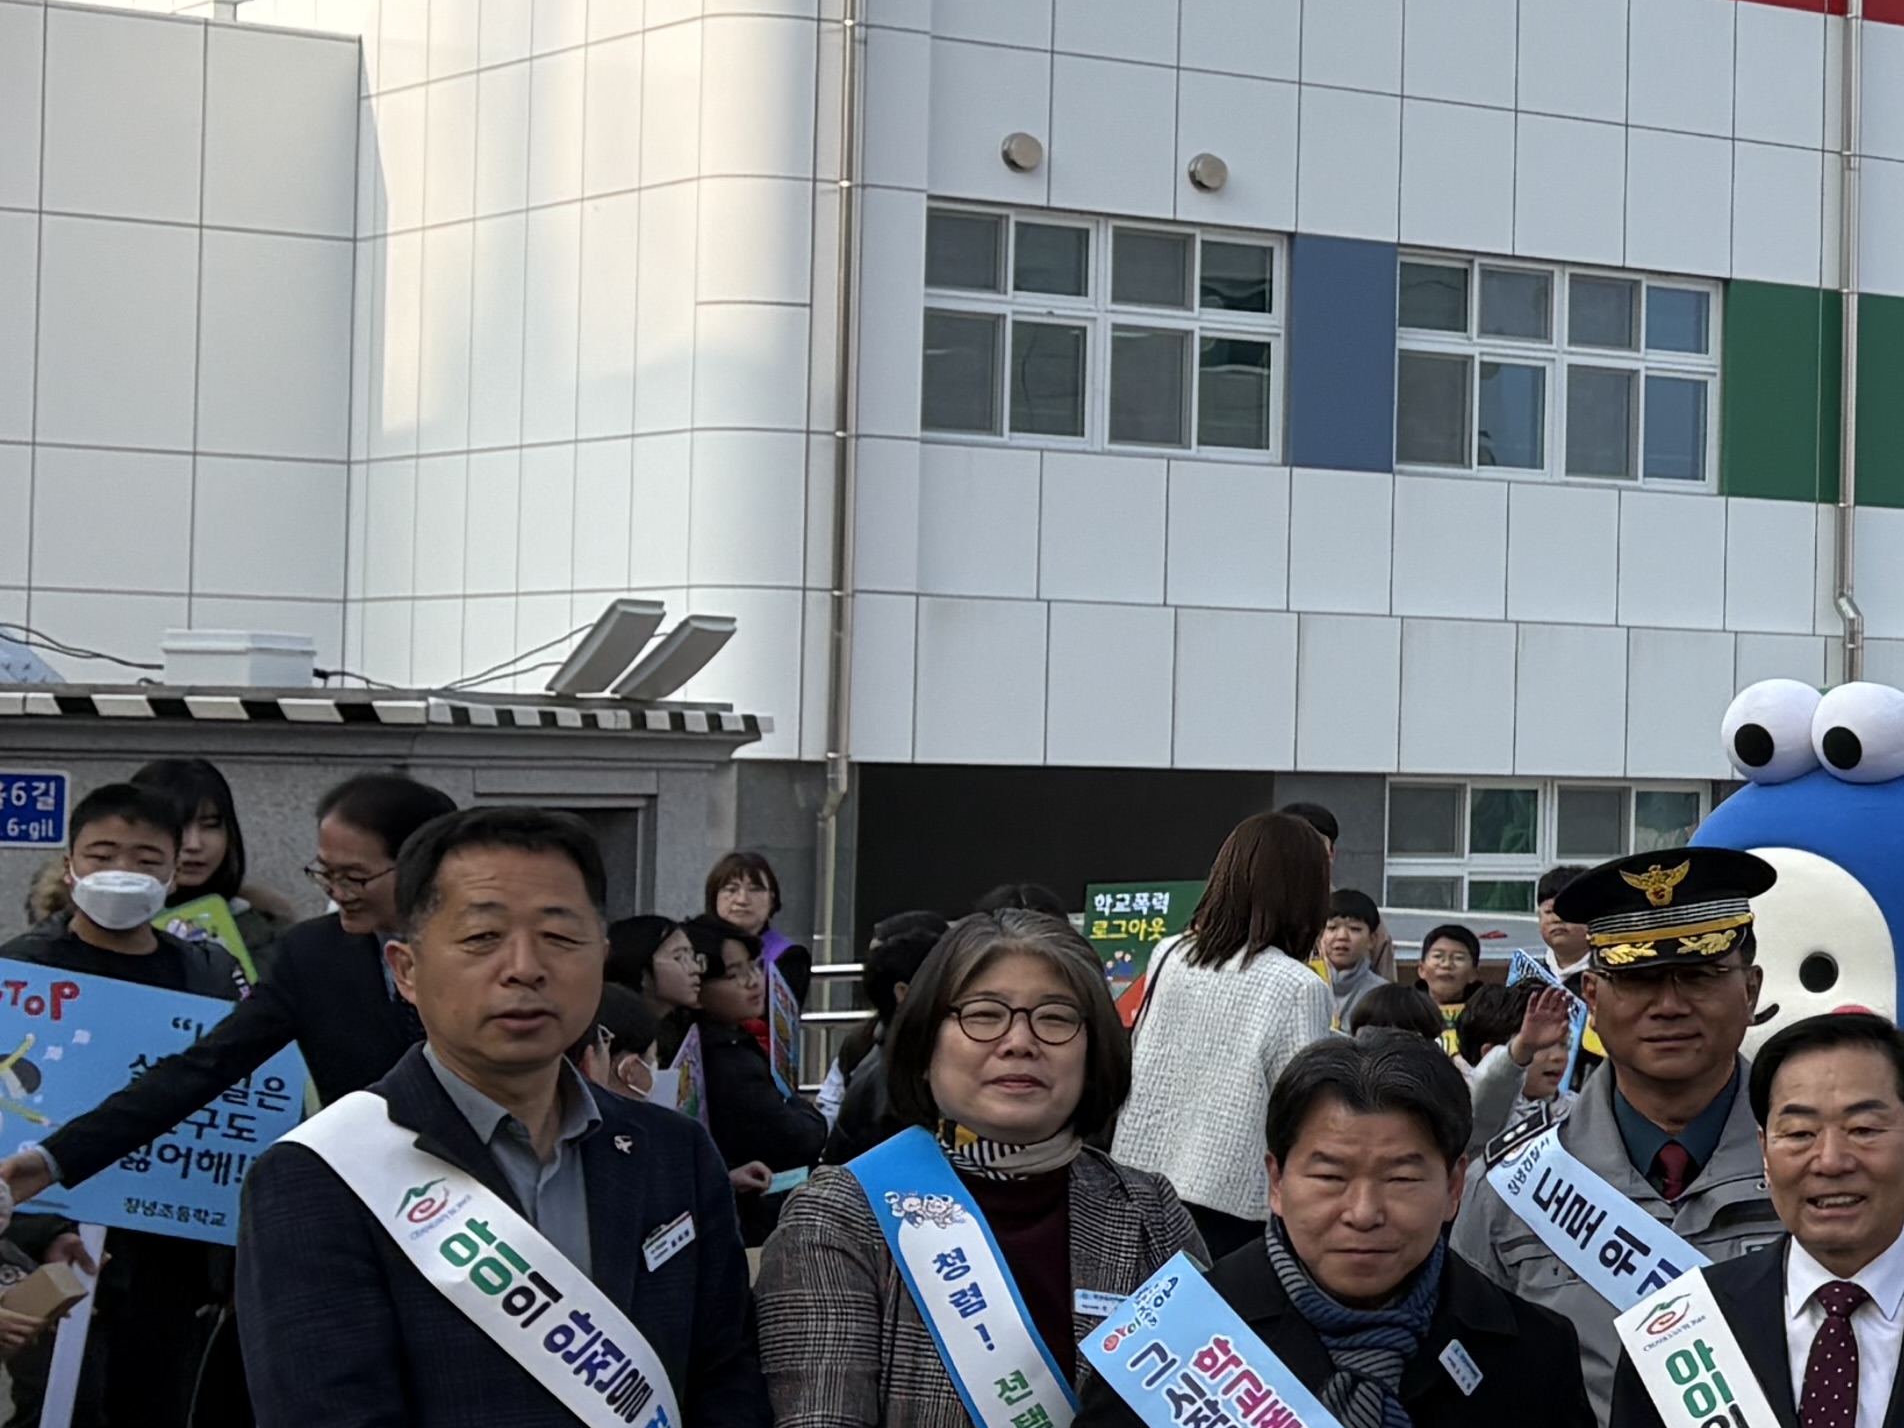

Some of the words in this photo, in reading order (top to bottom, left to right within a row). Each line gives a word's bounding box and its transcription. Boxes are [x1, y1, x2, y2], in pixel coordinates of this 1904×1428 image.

[7, 818, 54, 840] 6-gil
[1094, 891, 1170, 916] 학교폭력
[1090, 917, 1167, 941] 로그아웃
[0, 980, 80, 1021] TOP
[166, 1107, 258, 1142] 구도
[439, 1218, 564, 1329] 아이의
[543, 1310, 654, 1424] 안전을
[1127, 1340, 1178, 1388] 그
